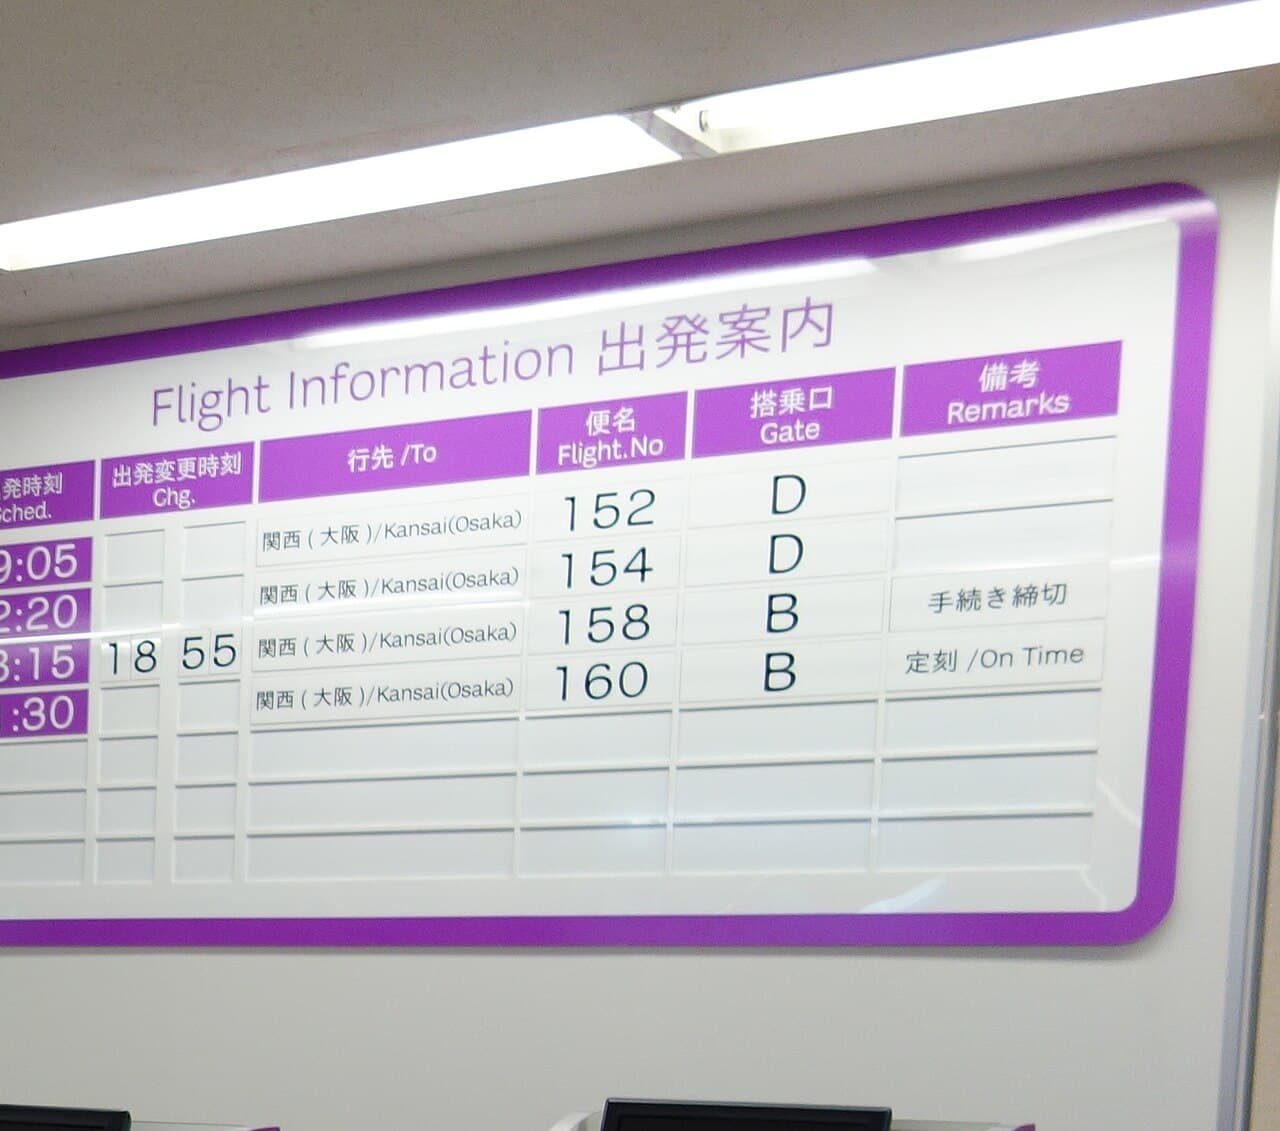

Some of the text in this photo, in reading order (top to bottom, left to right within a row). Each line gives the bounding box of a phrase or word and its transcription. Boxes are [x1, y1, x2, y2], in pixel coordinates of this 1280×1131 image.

[151, 297, 834, 432] Flight Information 出発案内
[979, 358, 1040, 392] 備考
[749, 386, 835, 416] 搭乗口
[946, 390, 1070, 425] Remarks
[585, 409, 636, 437] 便名
[759, 418, 820, 444] Gate
[112, 451, 241, 489] 出発変更時刻
[347, 446, 394, 473] 行先
[557, 435, 664, 468] Flight.No
[152, 486, 196, 510] Chg.
[563, 489, 656, 531] 152
[771, 474, 807, 515] D
[561, 546, 654, 588] 154
[768, 534, 804, 574] D
[765, 594, 799, 634] B
[928, 583, 1068, 613] 手続き締切
[558, 603, 652, 645] 158
[106, 632, 238, 677] 18 55
[763, 652, 797, 692] B
[905, 649, 958, 675] 定刻
[1020, 643, 1085, 669] Time
[555, 661, 649, 702] 160
